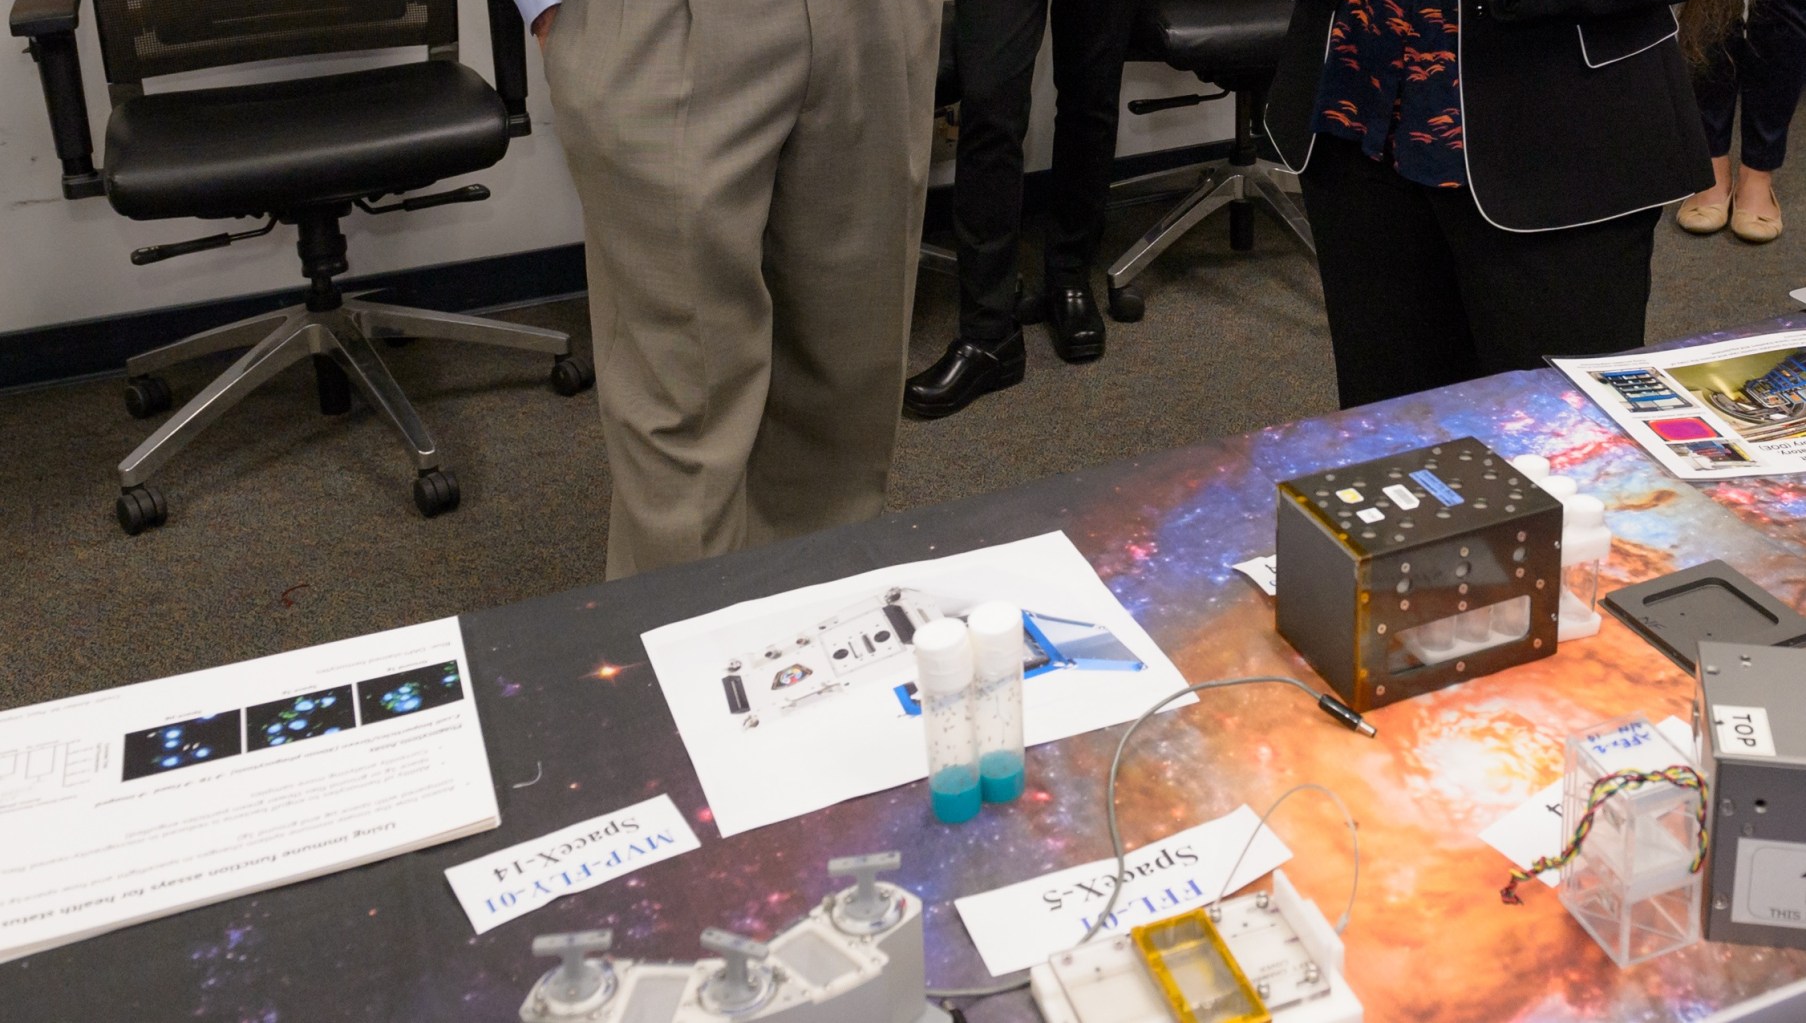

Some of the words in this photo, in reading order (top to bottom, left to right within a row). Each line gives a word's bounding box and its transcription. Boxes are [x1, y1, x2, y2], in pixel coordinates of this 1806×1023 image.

[1758, 442, 1792, 451] (DOE)
[1732, 713, 1757, 748] TOP
[353, 822, 395, 838] Using
[282, 835, 347, 856] immune
[493, 816, 641, 883] SpaceX-14
[208, 854, 276, 875] function
[485, 829, 675, 914] MVP-FLY-01
[150, 873, 202, 890] assays
[1042, 844, 1199, 912] SpaceX-5
[122, 888, 144, 898] for
[60, 895, 115, 914] health
[1081, 879, 1204, 932] FFL-01
[1769, 907, 1801, 921] THIS
[0, 910, 53, 929] status
